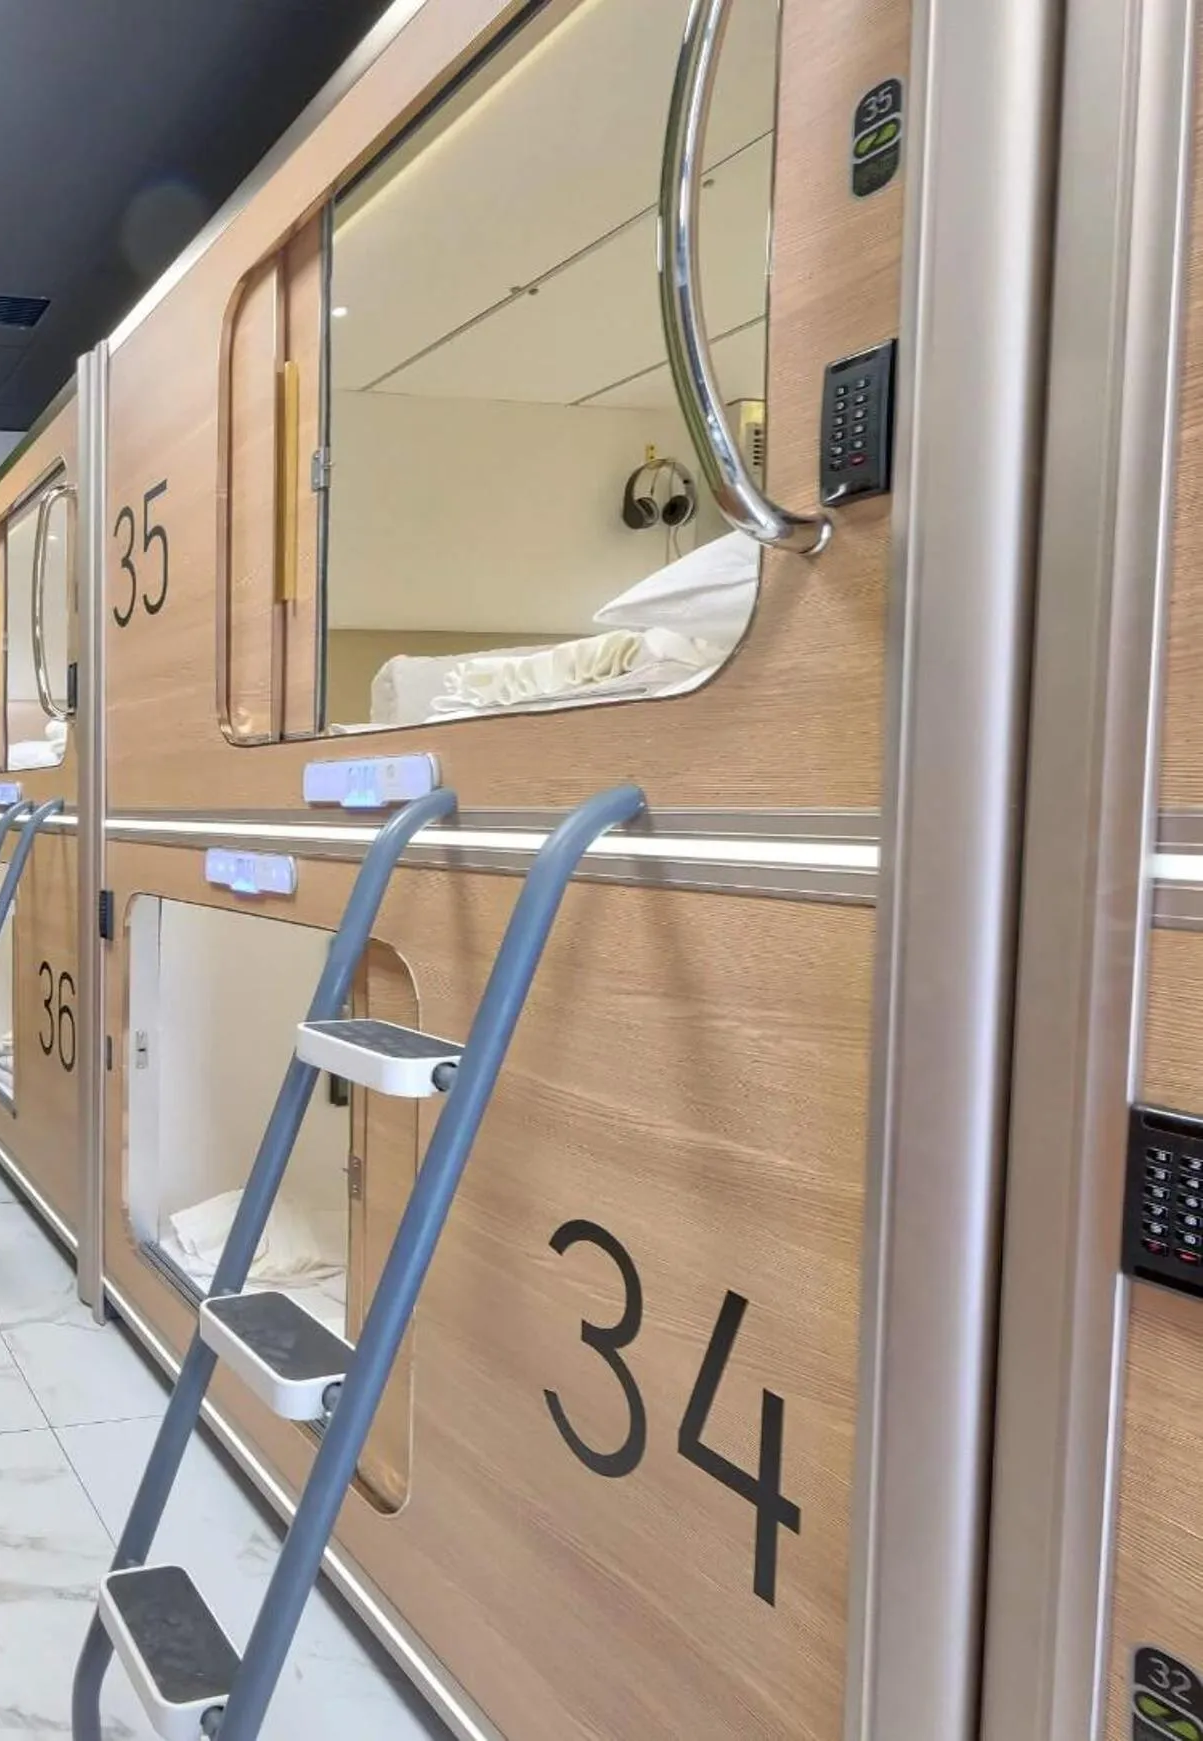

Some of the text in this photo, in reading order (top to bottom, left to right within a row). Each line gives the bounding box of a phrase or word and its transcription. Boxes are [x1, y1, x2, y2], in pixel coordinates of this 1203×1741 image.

[863, 86, 893, 122] 35
[113, 479, 169, 629] 35
[39, 960, 76, 1072] 36
[544, 1219, 801, 1608] 34
[1148, 1657, 1193, 1705] 32
